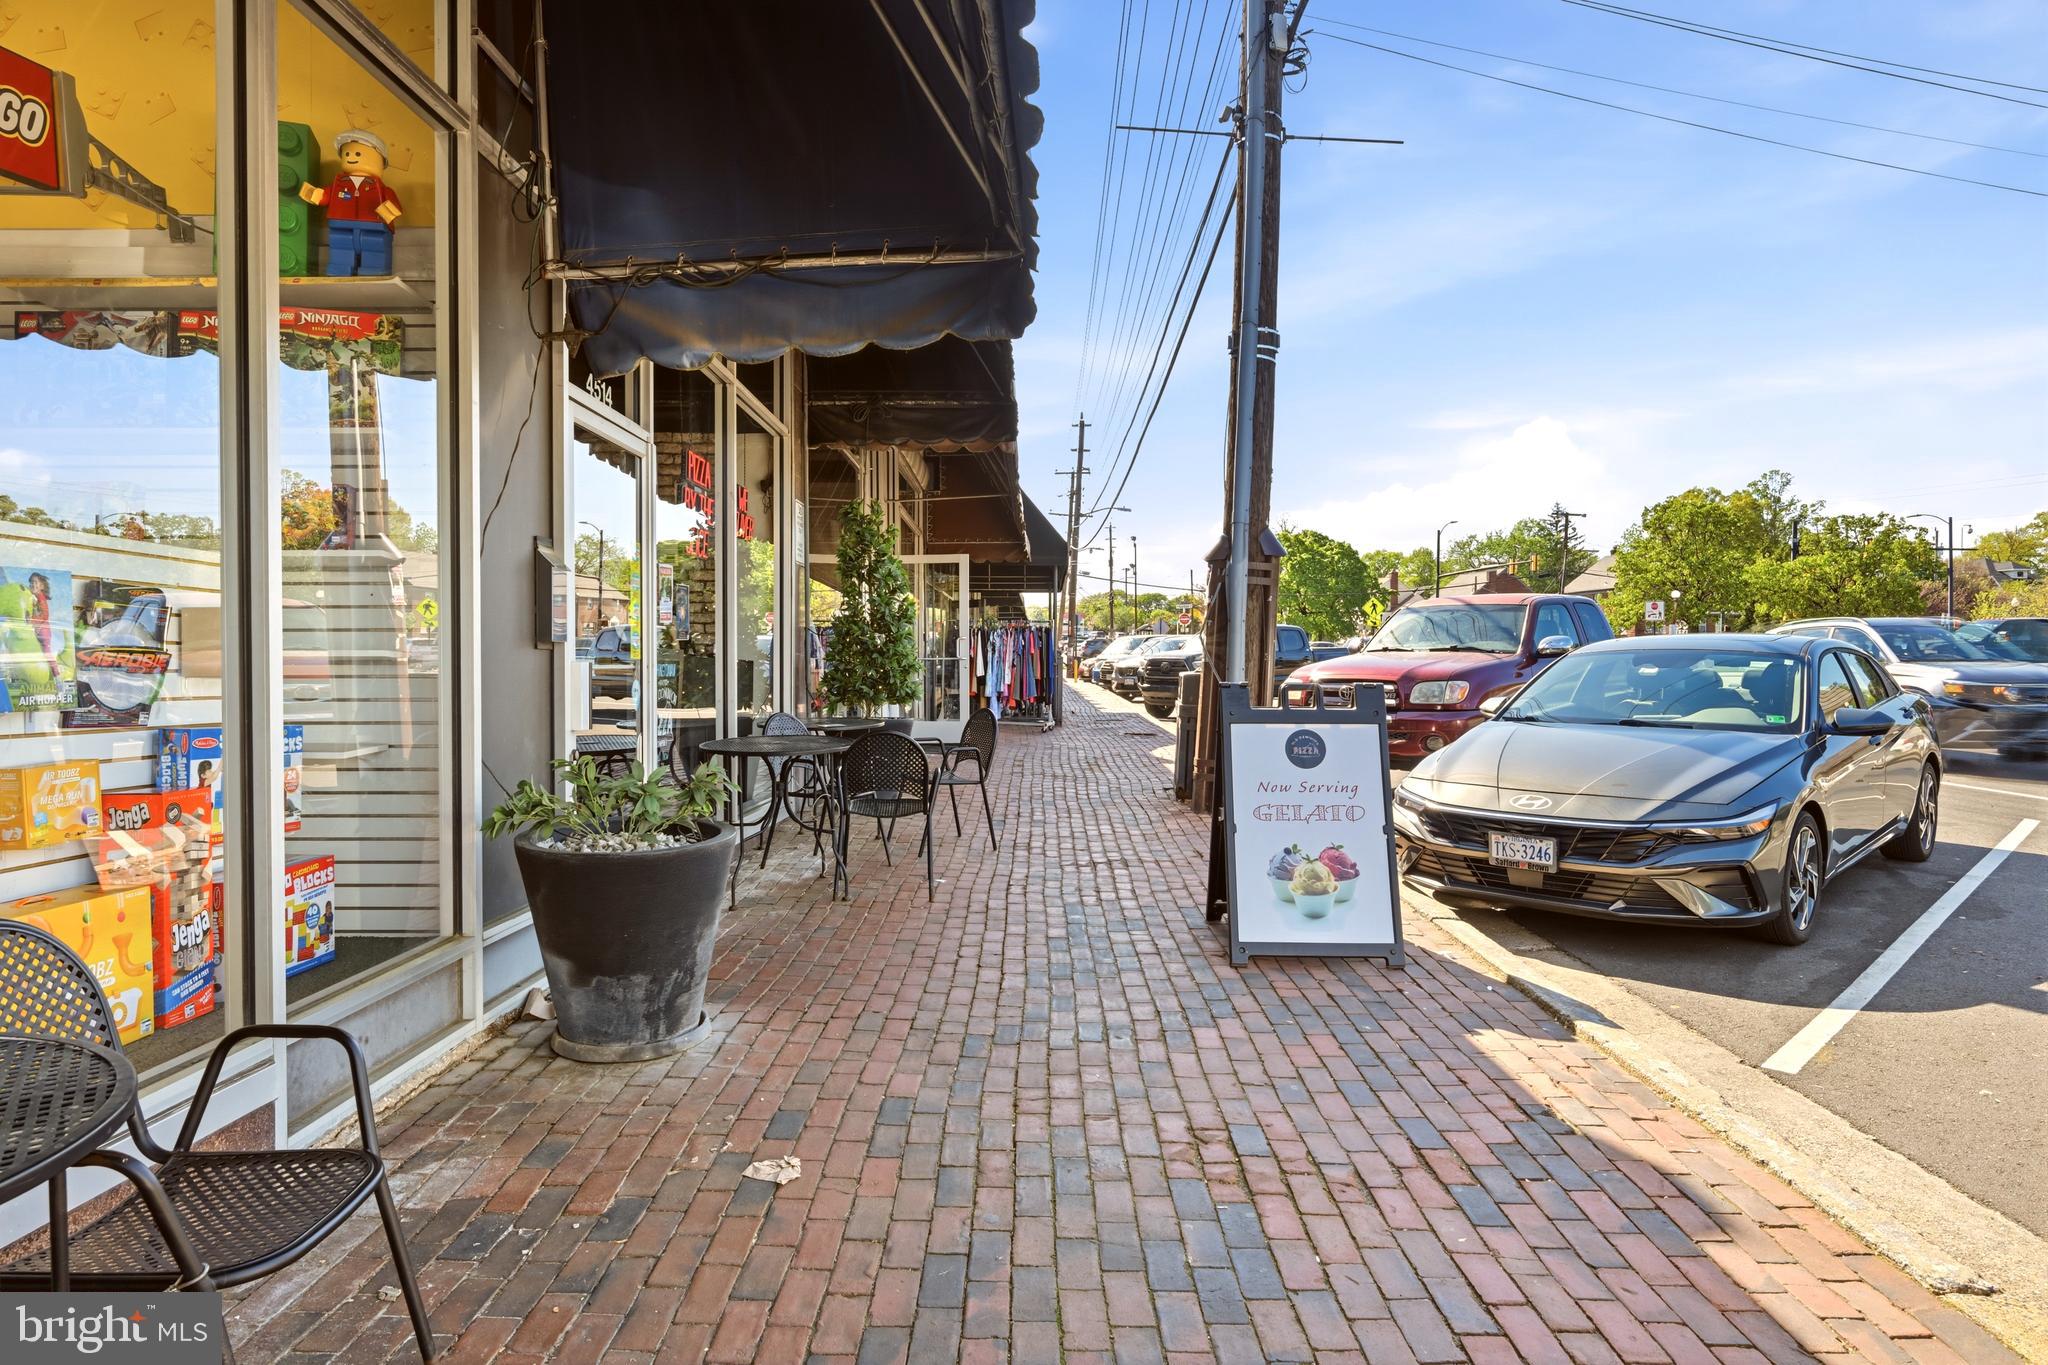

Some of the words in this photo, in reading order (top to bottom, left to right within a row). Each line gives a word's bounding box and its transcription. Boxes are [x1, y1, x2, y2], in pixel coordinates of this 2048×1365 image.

[0, 89, 47, 143] GO
[298, 311, 362, 330] NINJAGO
[586, 373, 612, 408] 4514
[688, 449, 712, 490] PIZZA
[19, 696, 36, 706] AIR
[37, 694, 73, 705] HOPPER
[284, 736, 303, 752] CKS
[1257, 781, 1292, 793] Now
[1298, 781, 1359, 799] Serving
[109, 803, 150, 830] Jenga
[1253, 804, 1366, 824] GELATO
[293, 866, 335, 892] BLOCKS
[172, 909, 211, 953] Jenga
